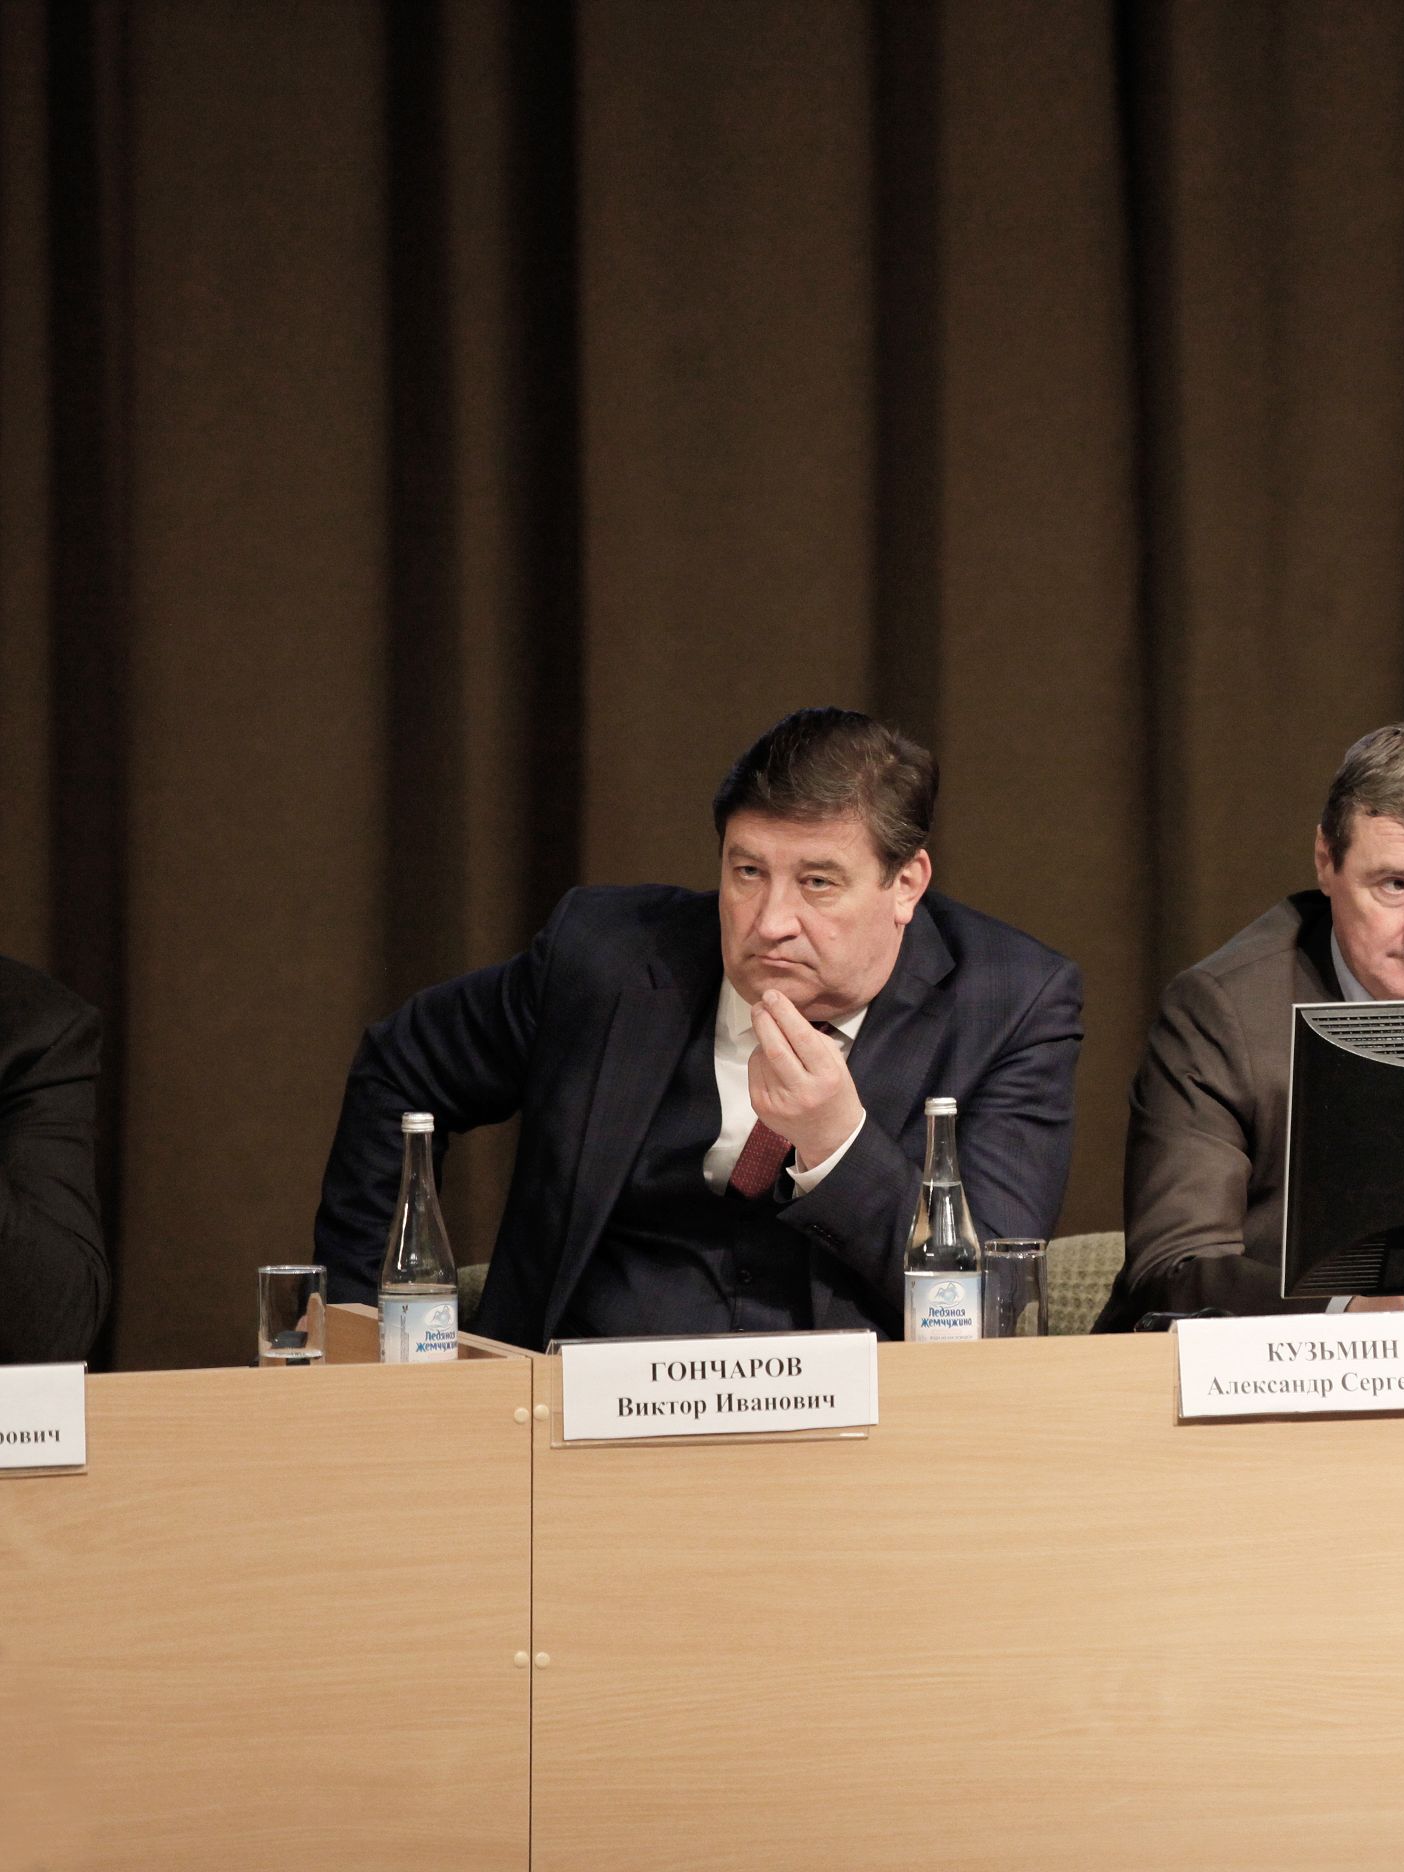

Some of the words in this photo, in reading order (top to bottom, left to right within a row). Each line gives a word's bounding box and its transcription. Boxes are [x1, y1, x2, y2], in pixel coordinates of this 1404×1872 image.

[928, 1306, 966, 1318] Ледяная
[1266, 1339, 1399, 1363] КУЗЬМИН
[650, 1356, 803, 1383] ГОНЧАРОВ
[1207, 1376, 1334, 1398] Александр
[617, 1396, 708, 1420] Виктор
[716, 1392, 836, 1414] Иванович
